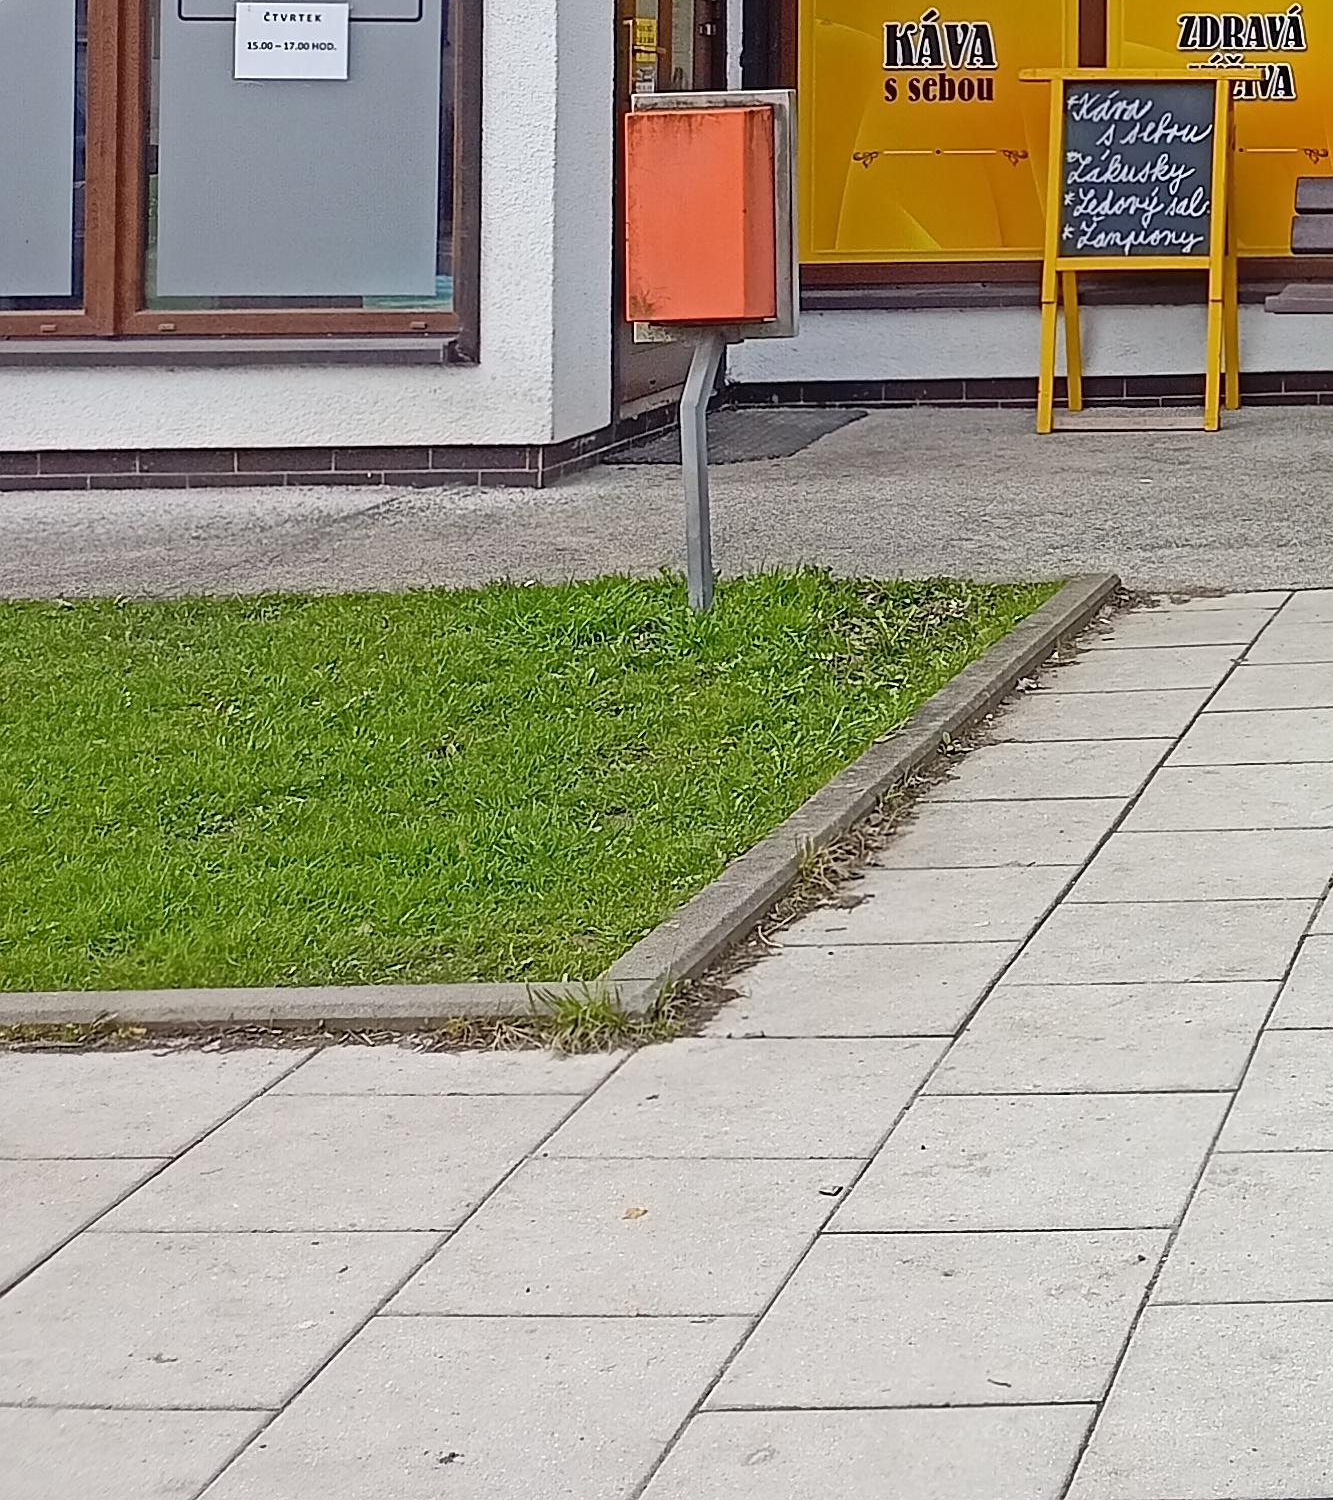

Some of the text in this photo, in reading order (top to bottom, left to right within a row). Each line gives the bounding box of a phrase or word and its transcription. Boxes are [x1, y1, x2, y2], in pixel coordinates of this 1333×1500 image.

[263, 11, 323, 22] ČTVRTEK
[1178, 4, 1306, 49] ZDRAVÁ
[247, 41, 273, 50] 15.00
[284, 42, 310, 51] 17.00
[884, 9, 997, 68] KÁVA
[884, 72, 994, 102] s sebou
[1096, 113, 1213, 146] s sebou
[1067, 150, 1195, 195] Zákusky
